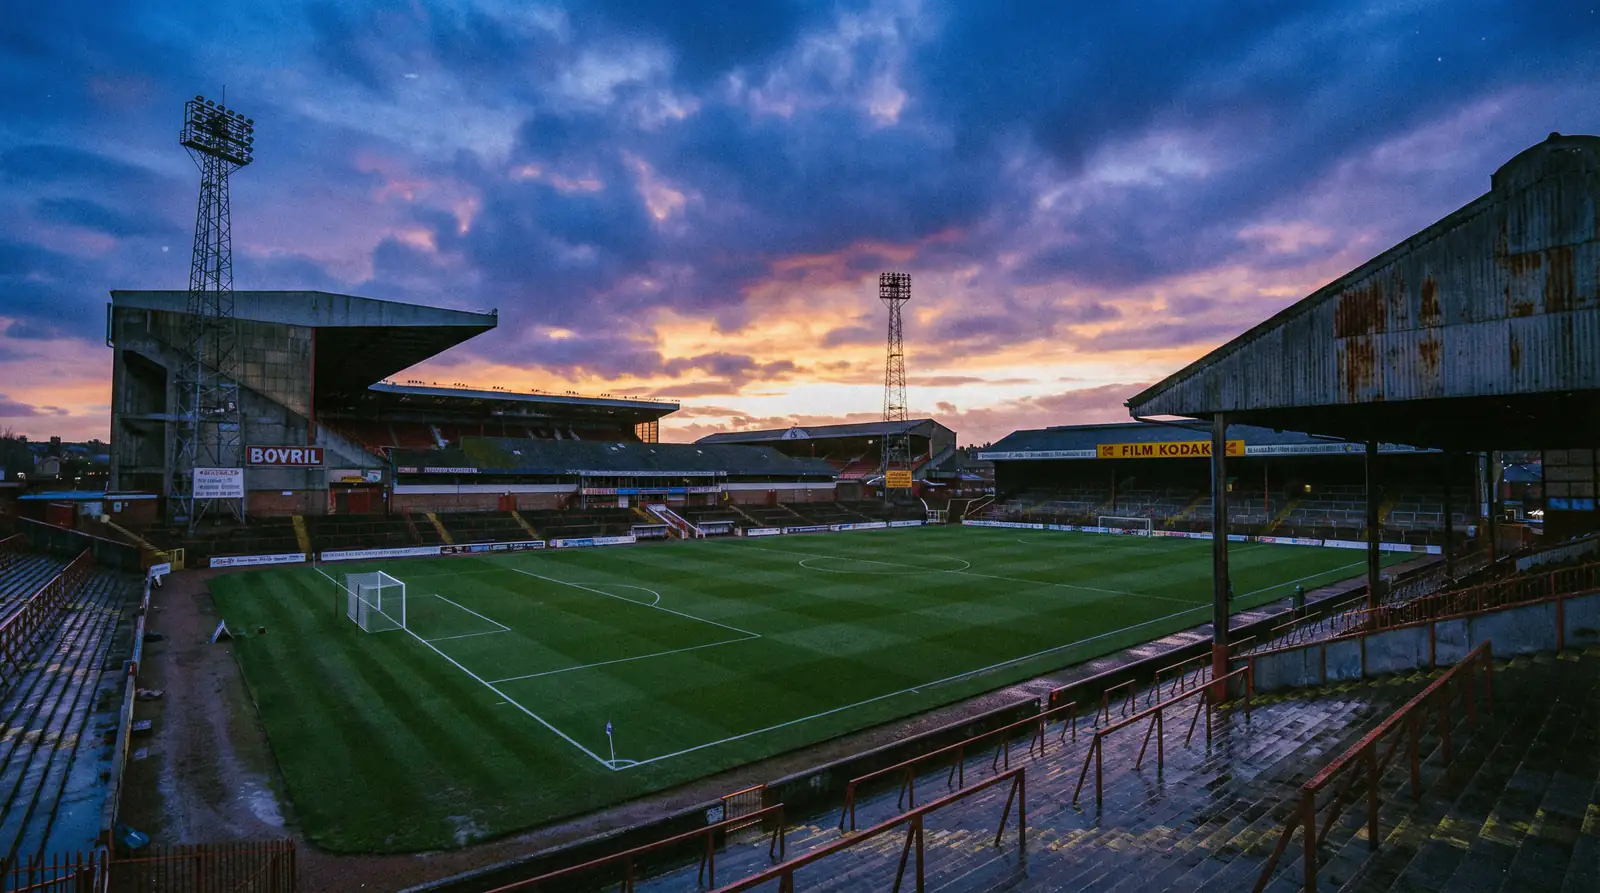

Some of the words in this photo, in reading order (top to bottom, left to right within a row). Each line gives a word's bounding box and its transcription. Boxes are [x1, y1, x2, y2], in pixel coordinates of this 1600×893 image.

[251, 448, 320, 464] BOVRIL
[1122, 445, 1153, 456] FILM
[1159, 444, 1212, 456] KODAK
